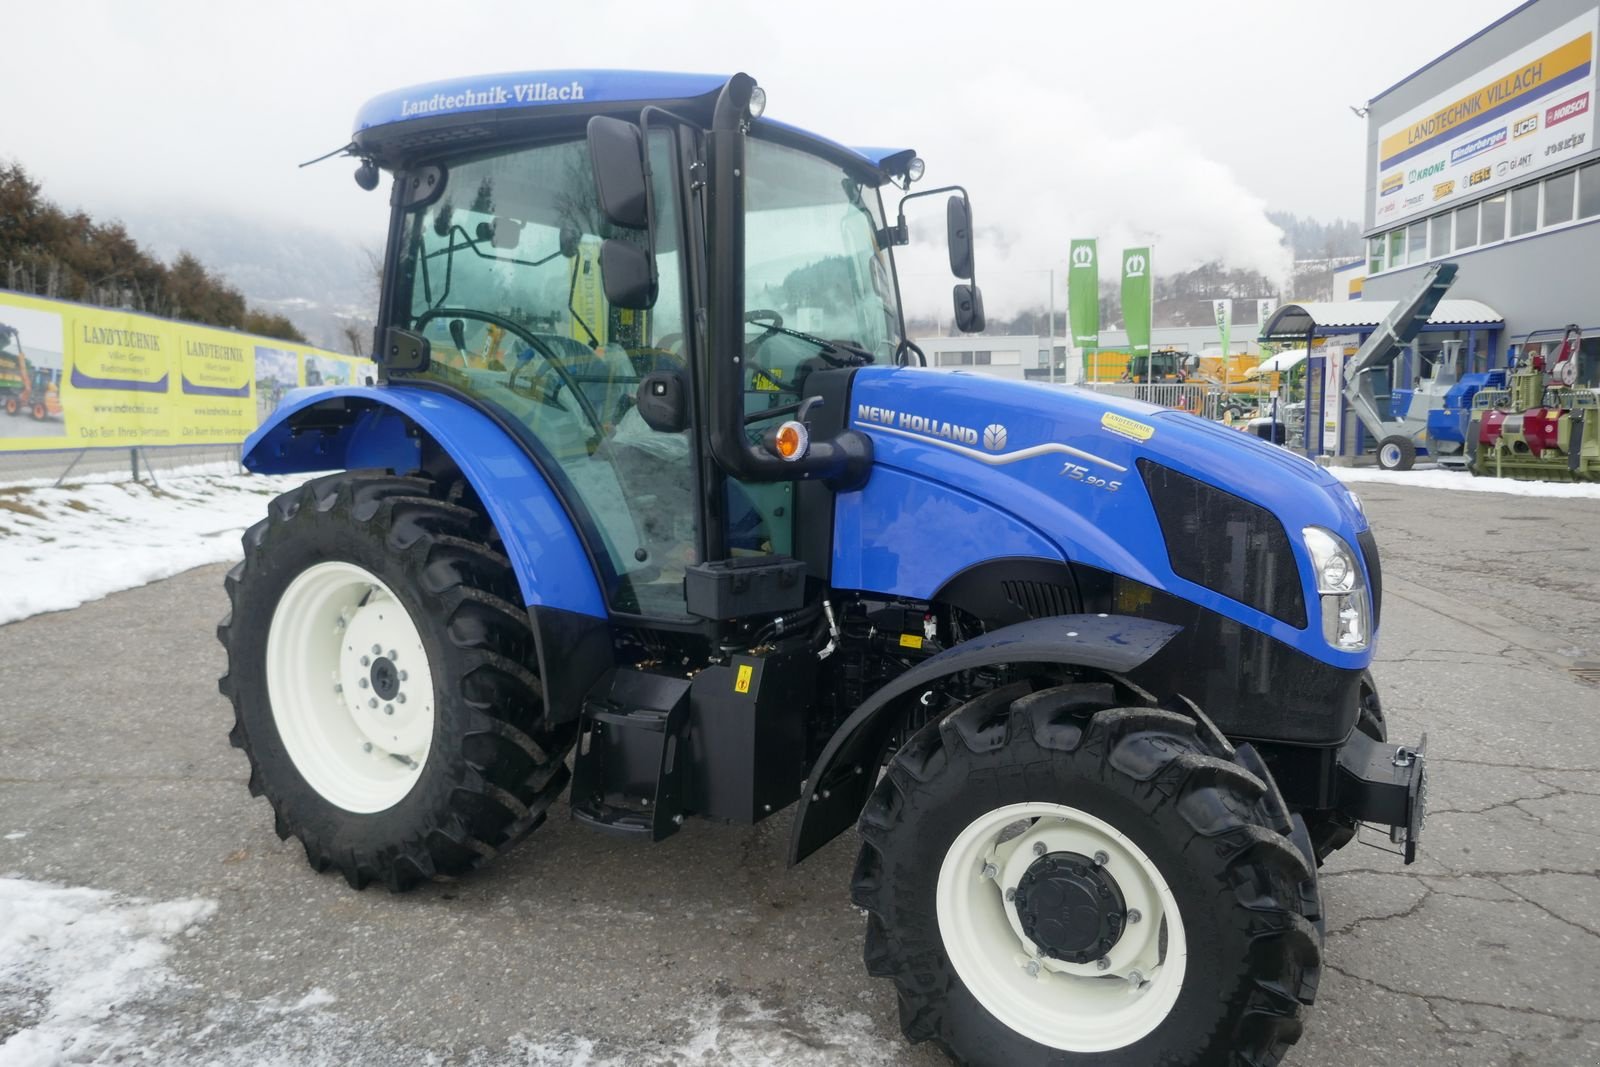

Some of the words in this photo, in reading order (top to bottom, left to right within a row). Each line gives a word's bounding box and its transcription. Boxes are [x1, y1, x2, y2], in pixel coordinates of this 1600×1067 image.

[402, 81, 584, 116] Landtechnik-Villach
[1408, 93, 1482, 144] LANDTECHNIK
[1487, 63, 1542, 104] VILLACH
[1553, 97, 1587, 120] HORSCH
[1514, 118, 1537, 137] JCB
[1417, 161, 1446, 181] KRONE
[84, 325, 160, 351] LANDTECHNIK
[186, 340, 244, 362] LANDTECHNIK
[858, 404, 895, 425] NEW
[899, 412, 978, 445] HOLLAND
[1106, 412, 1151, 433] LANDTECHNIK
